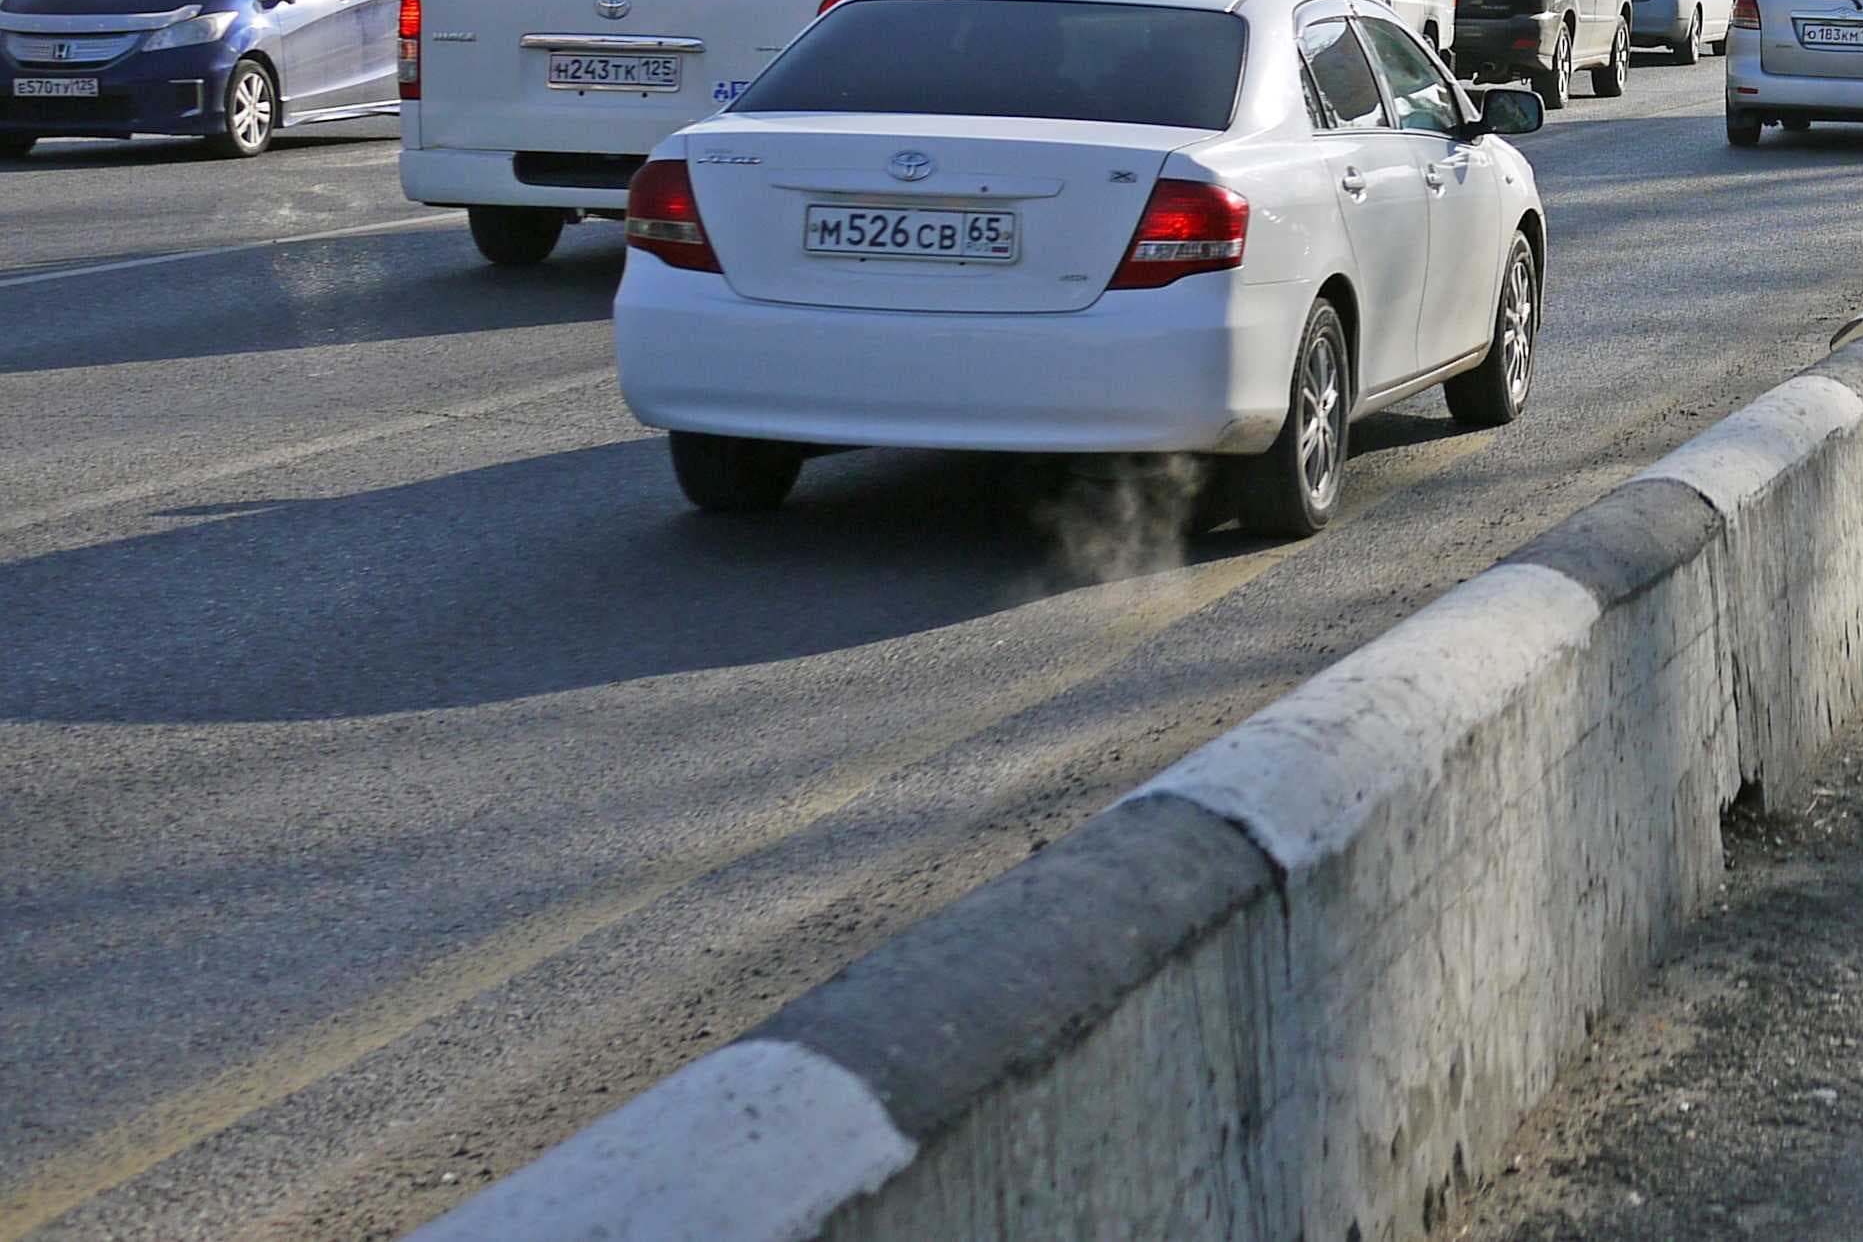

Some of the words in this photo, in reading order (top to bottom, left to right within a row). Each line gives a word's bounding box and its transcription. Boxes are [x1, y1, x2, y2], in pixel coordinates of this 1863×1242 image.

[557, 59, 637, 80] Н243ТК
[642, 59, 673, 76] 125
[819, 214, 957, 250] М526СВ
[968, 217, 1001, 242] 65
